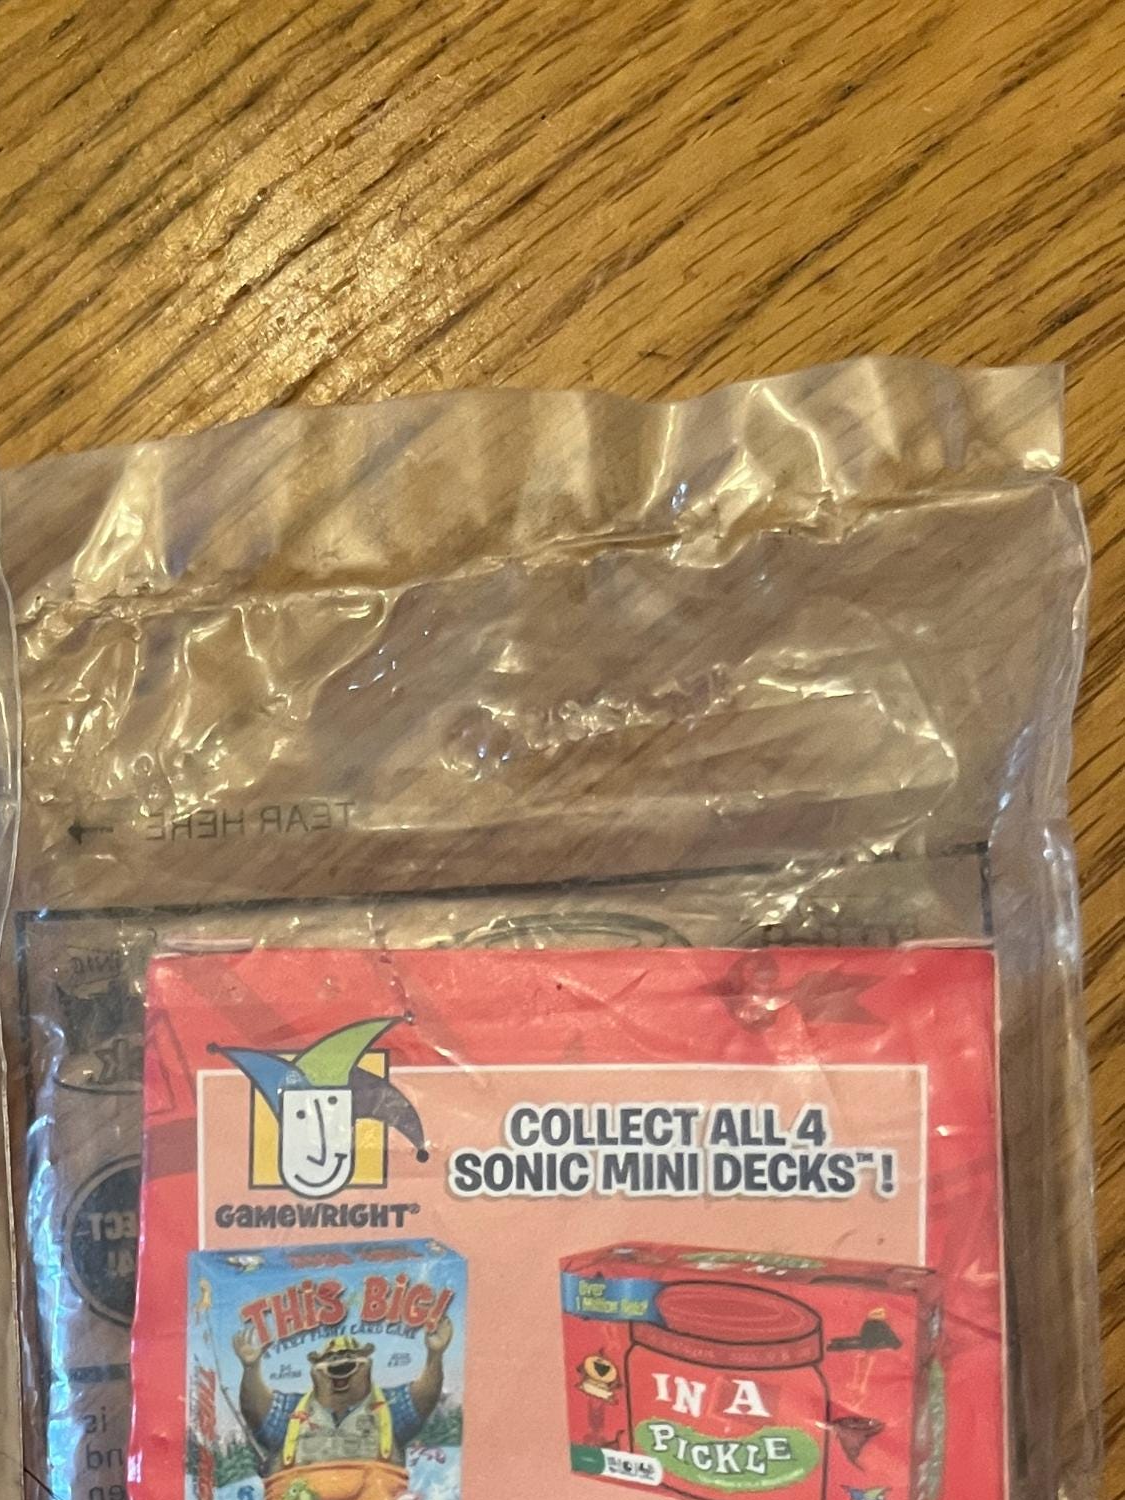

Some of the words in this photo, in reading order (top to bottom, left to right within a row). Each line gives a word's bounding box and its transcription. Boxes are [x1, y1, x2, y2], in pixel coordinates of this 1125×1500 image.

[510, 1107, 698, 1146] COLLECT
[710, 1107, 787, 1147] ALL
[796, 1108, 827, 1147] 4
[454, 1152, 589, 1192] SONIC
[602, 1152, 699, 1192] MINI
[650, 1372, 706, 1418] IN
[723, 1379, 772, 1418] A
[648, 1423, 792, 1475] PICKLE
